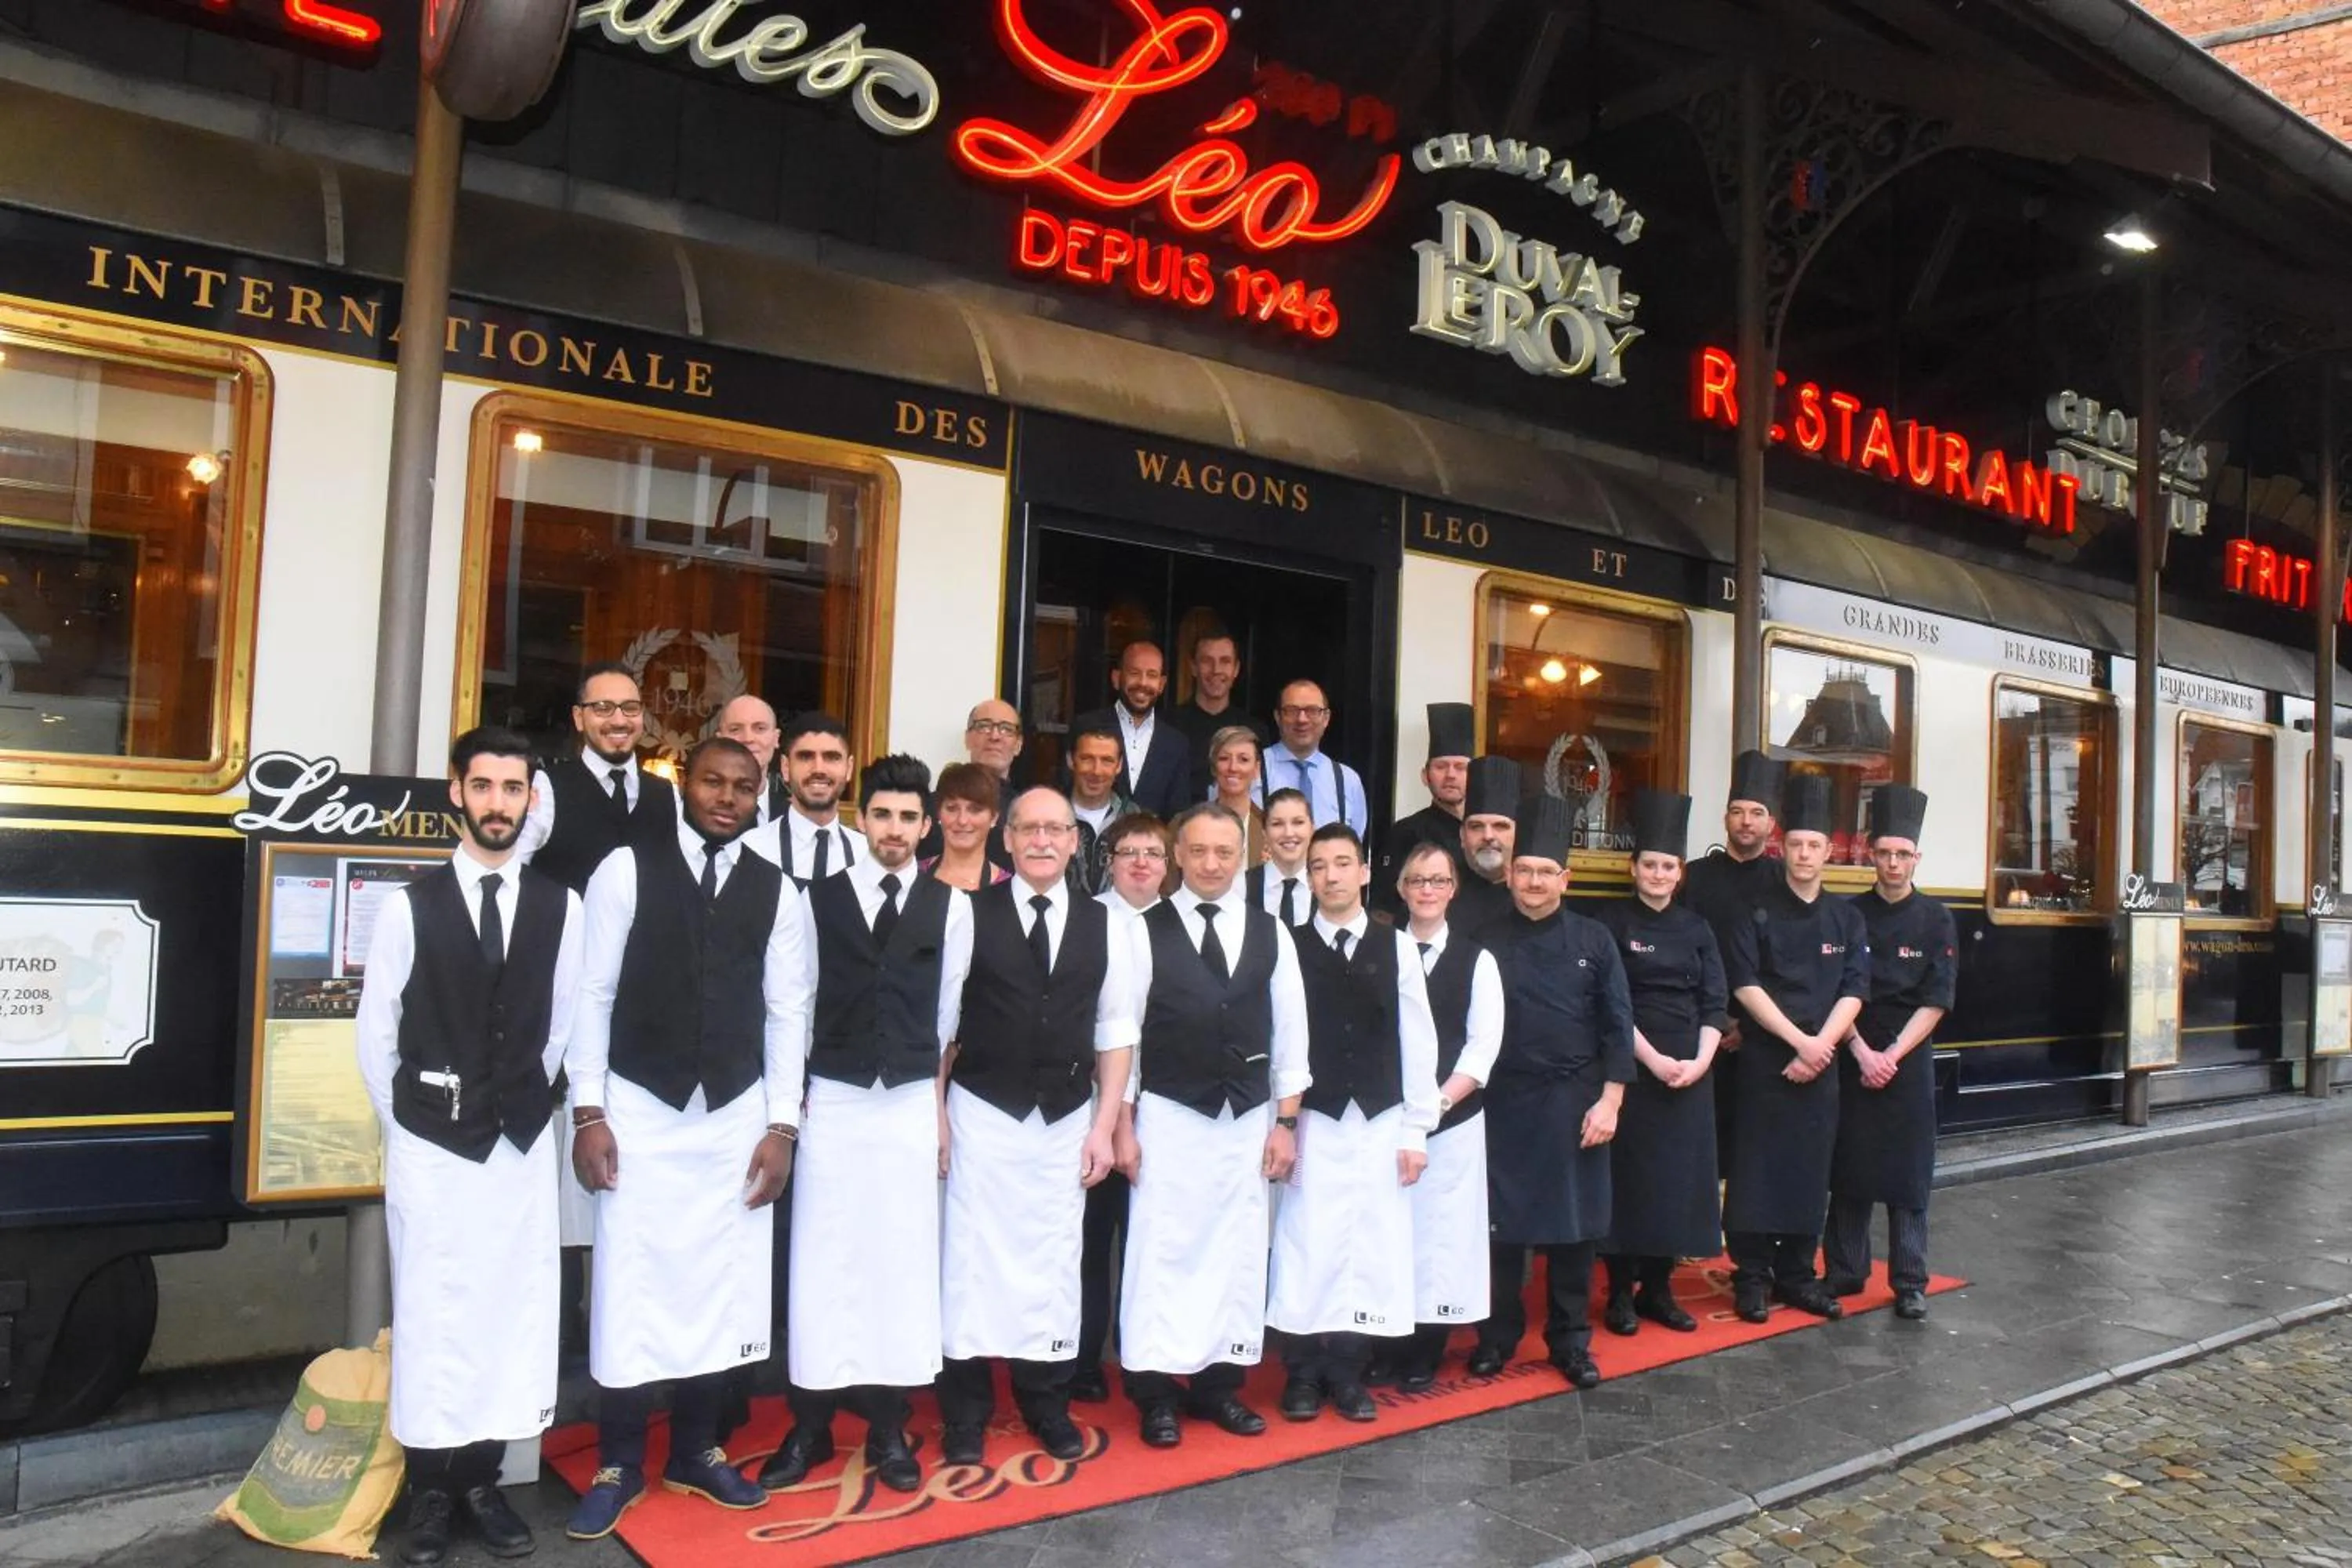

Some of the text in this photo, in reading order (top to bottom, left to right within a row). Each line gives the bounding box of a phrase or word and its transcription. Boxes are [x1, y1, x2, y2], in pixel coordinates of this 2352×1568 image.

[952, 0, 1401, 250] Léo
[1017, 207, 1339, 339] DEPUIS 1946
[86, 245, 713, 397] INTERNTIONALE
[895, 401, 989, 448] DES
[1135, 448, 1308, 512] WAGONS
[1421, 511, 1489, 549] LEO
[1592, 548, 1627, 578] ET
[1843, 604, 1940, 644] GRANDES
[2005, 639, 2105, 681] BRASSERIES
[1698, 347, 2082, 535] RSTAURANT
[234, 753, 470, 840] Léo MEN
[2122, 873, 2160, 909] Léo
[10, 1004, 44, 1015] 2013
[15, 989, 53, 1001] 2008,
